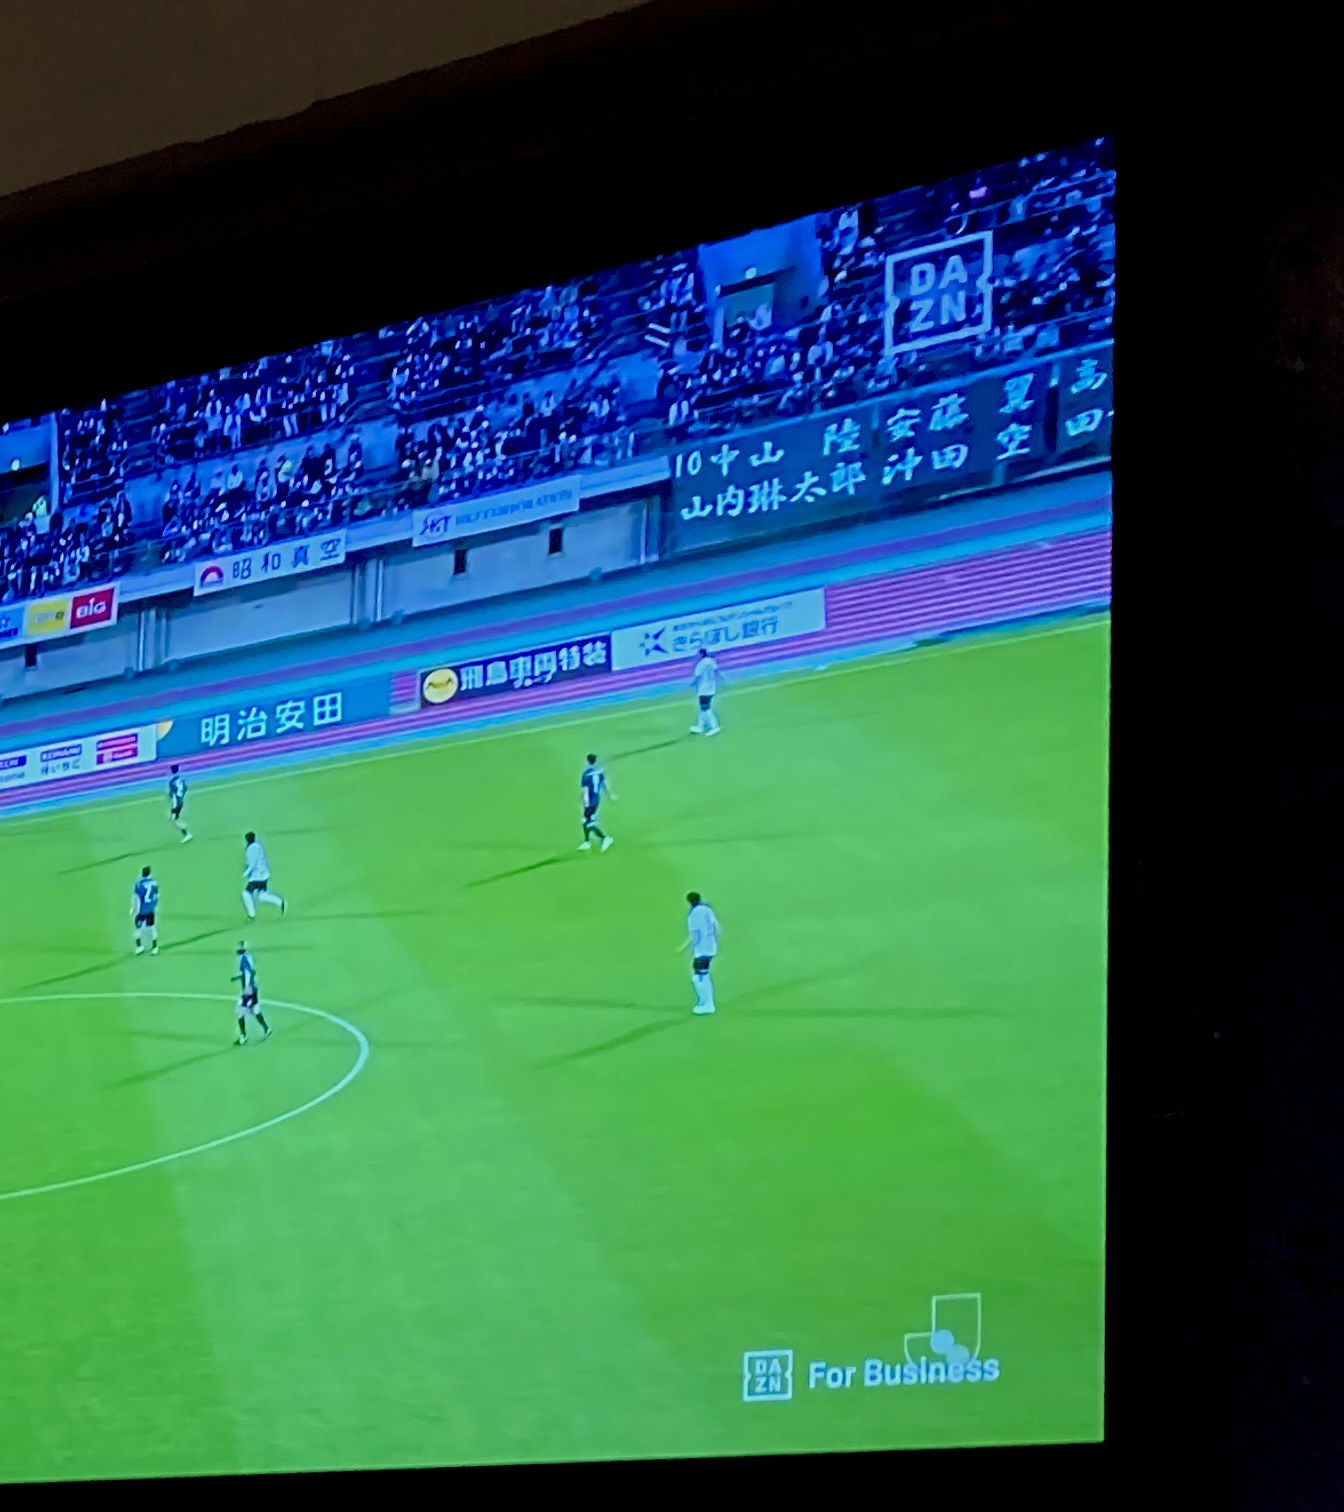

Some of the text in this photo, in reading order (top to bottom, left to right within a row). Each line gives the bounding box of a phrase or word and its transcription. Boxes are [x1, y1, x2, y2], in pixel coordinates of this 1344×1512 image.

[200, 691, 343, 747] 明治安田
[807, 1361, 857, 1389] For
[864, 1355, 1000, 1388] Business
